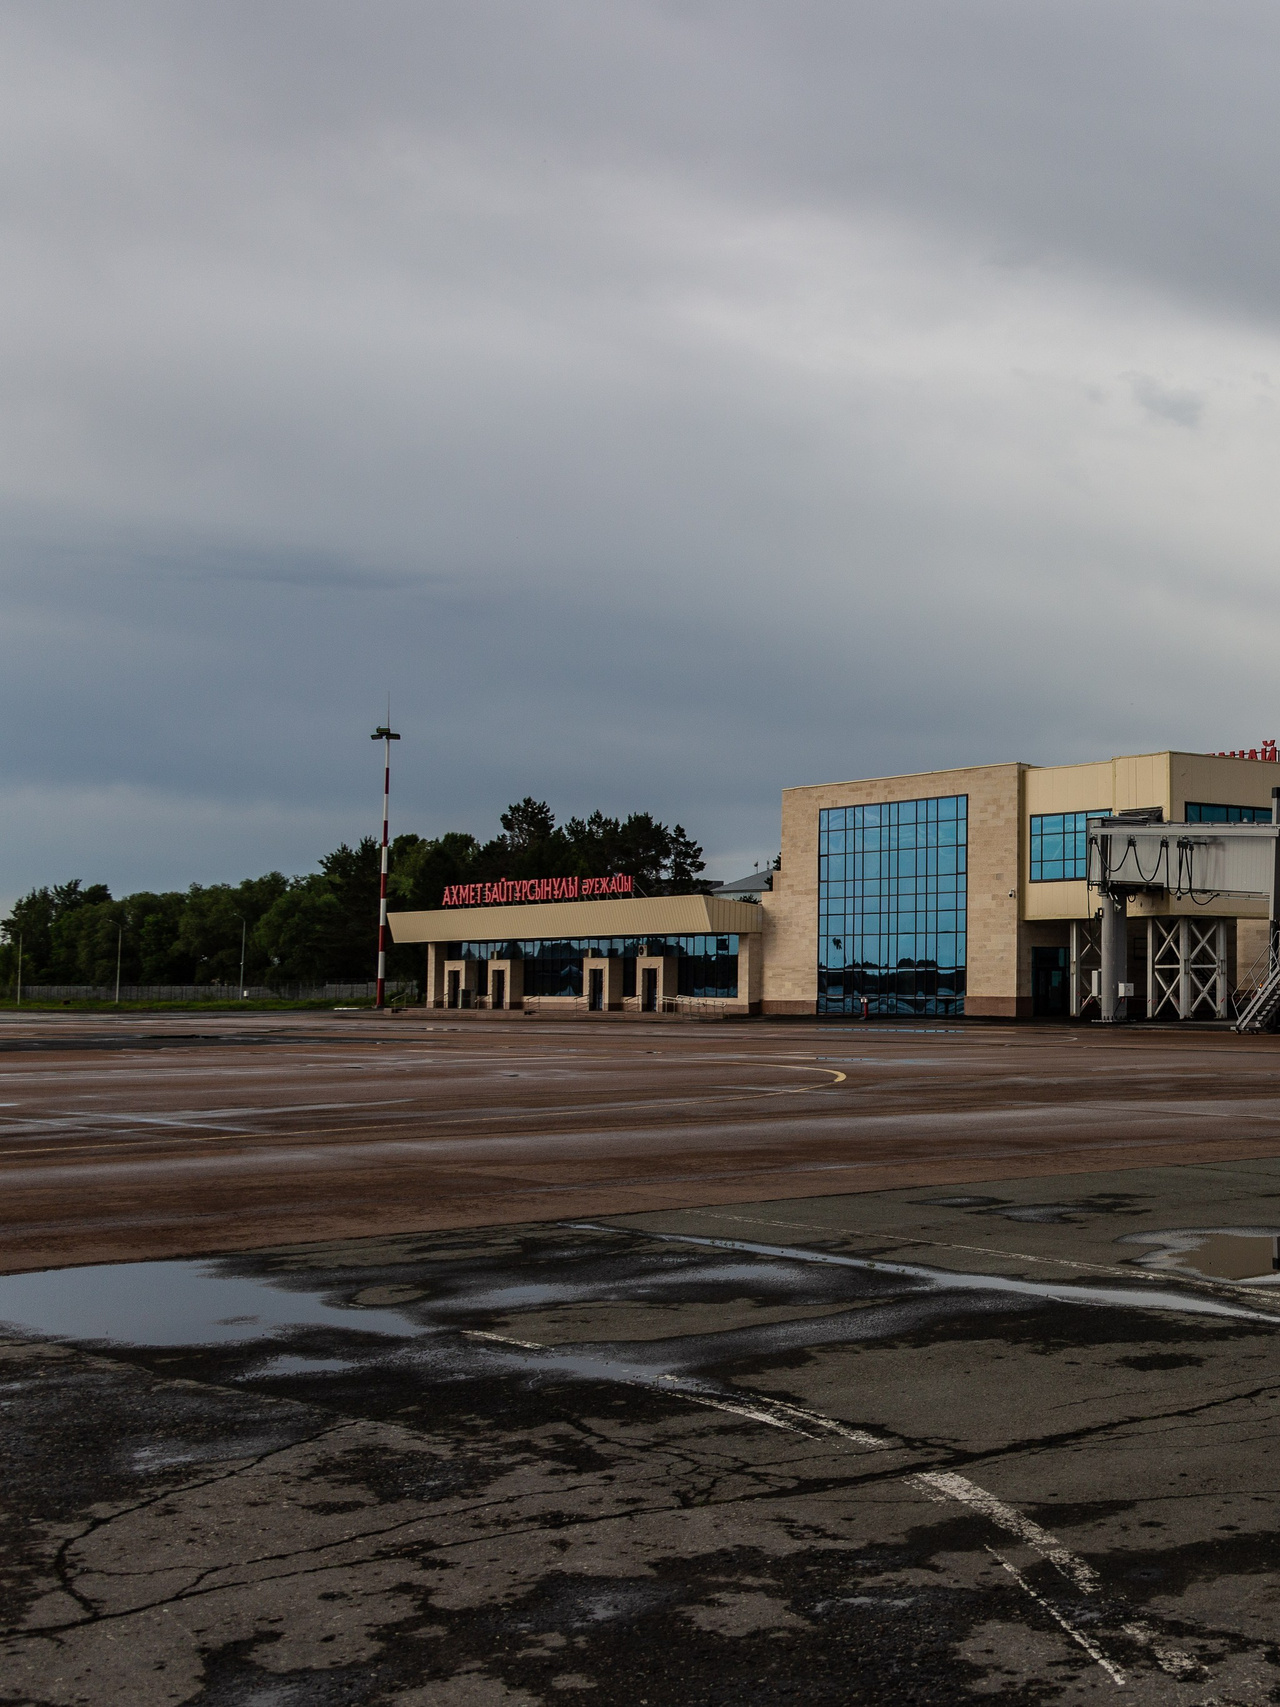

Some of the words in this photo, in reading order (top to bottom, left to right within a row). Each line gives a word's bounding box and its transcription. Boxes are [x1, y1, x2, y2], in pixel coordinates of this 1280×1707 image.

[442, 884, 483, 906] АХМЕТ
[484, 877, 580, 903] БАЙТҰРСЫНҰЛЫ
[581, 873, 634, 895] ӘУЕЖАЙЫ
